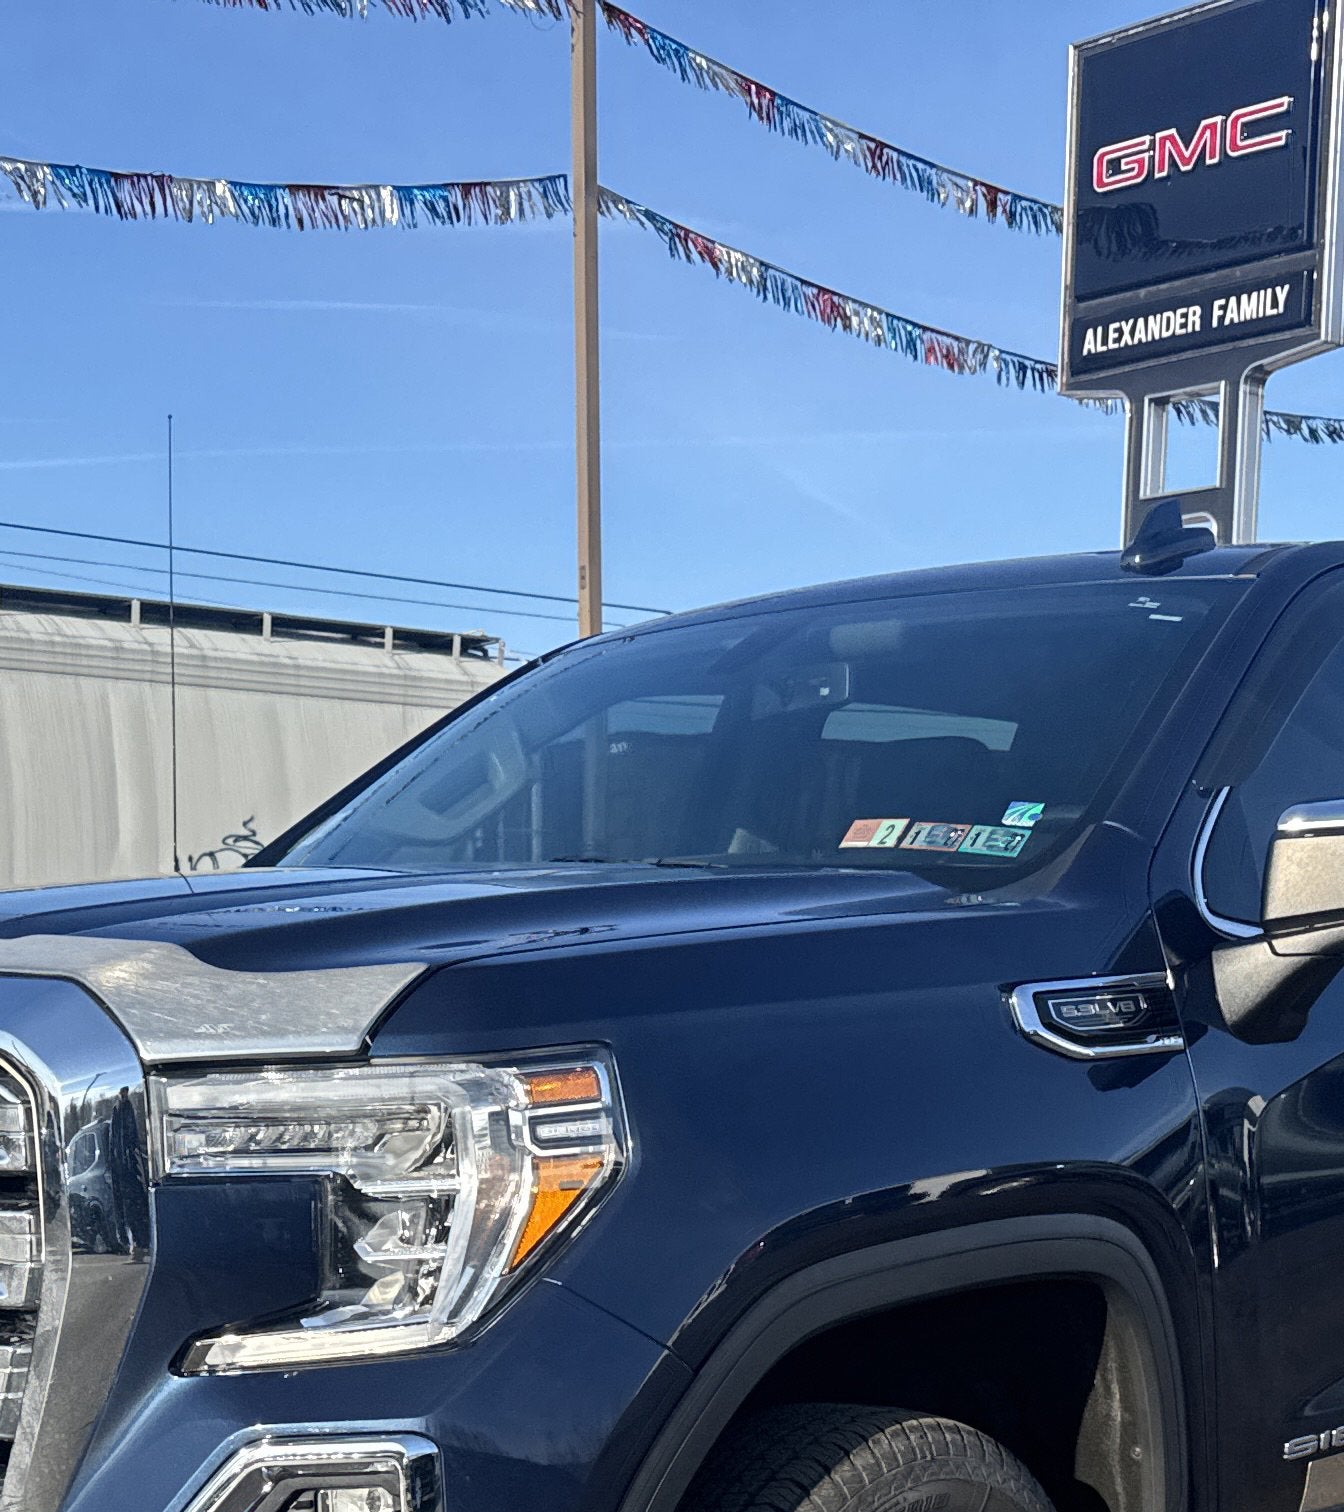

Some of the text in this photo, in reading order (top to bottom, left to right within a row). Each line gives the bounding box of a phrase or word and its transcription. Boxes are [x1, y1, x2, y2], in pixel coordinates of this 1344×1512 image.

[1093, 96, 1293, 192] GMC
[1082, 284, 1290, 356] ALEXANDER FAMILY
